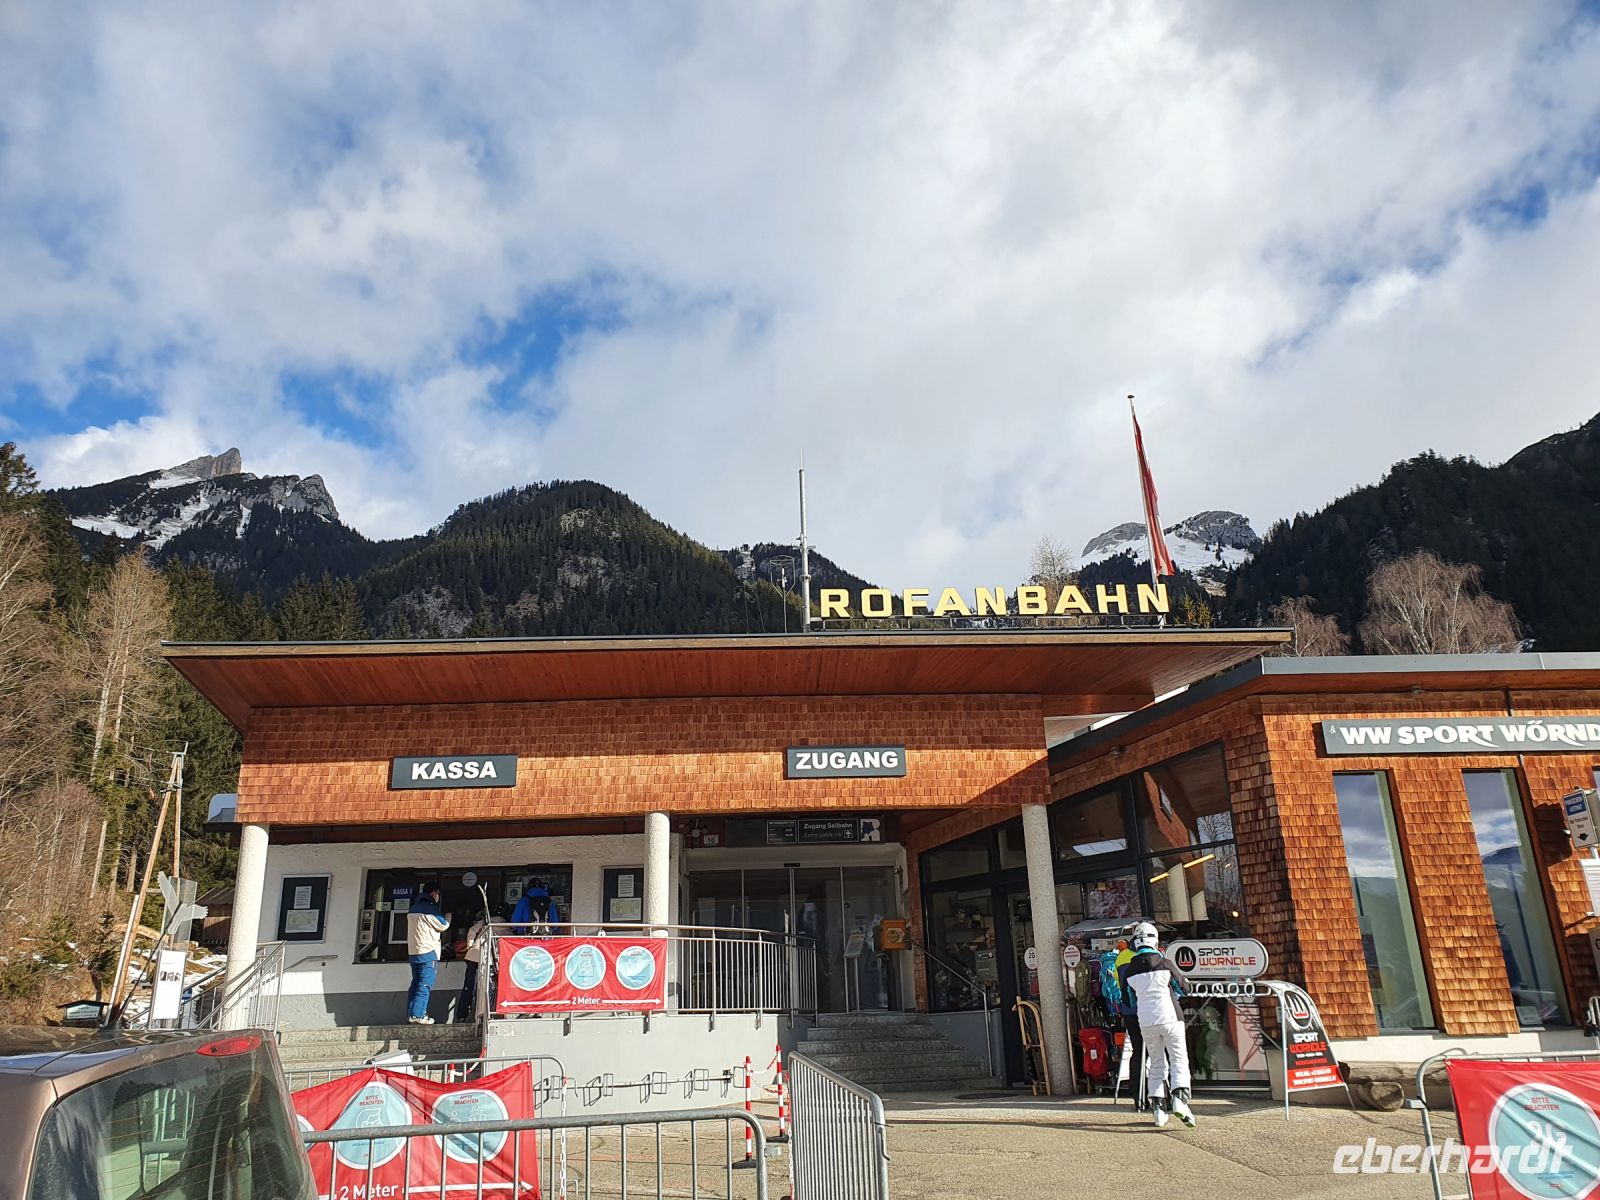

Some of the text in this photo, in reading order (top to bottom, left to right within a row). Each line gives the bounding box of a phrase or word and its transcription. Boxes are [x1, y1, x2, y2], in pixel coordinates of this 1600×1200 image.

[820, 583, 1170, 618] ROFANBAHN
[1339, 726, 1392, 745] WW
[1397, 725, 1500, 748] SPORT
[795, 751, 899, 769] ZUGANG
[411, 761, 497, 780] KASSA
[1198, 947, 1236, 956] SPORT
[525, 959, 540, 970] 2G
[571, 997, 601, 1005] 2 Meter
[1293, 1032, 1319, 1043] SPORT
[1530, 1096, 1551, 1104] BITTE
[1524, 1103, 1560, 1111] BEACHTEN
[340, 1185, 349, 1200] 2
